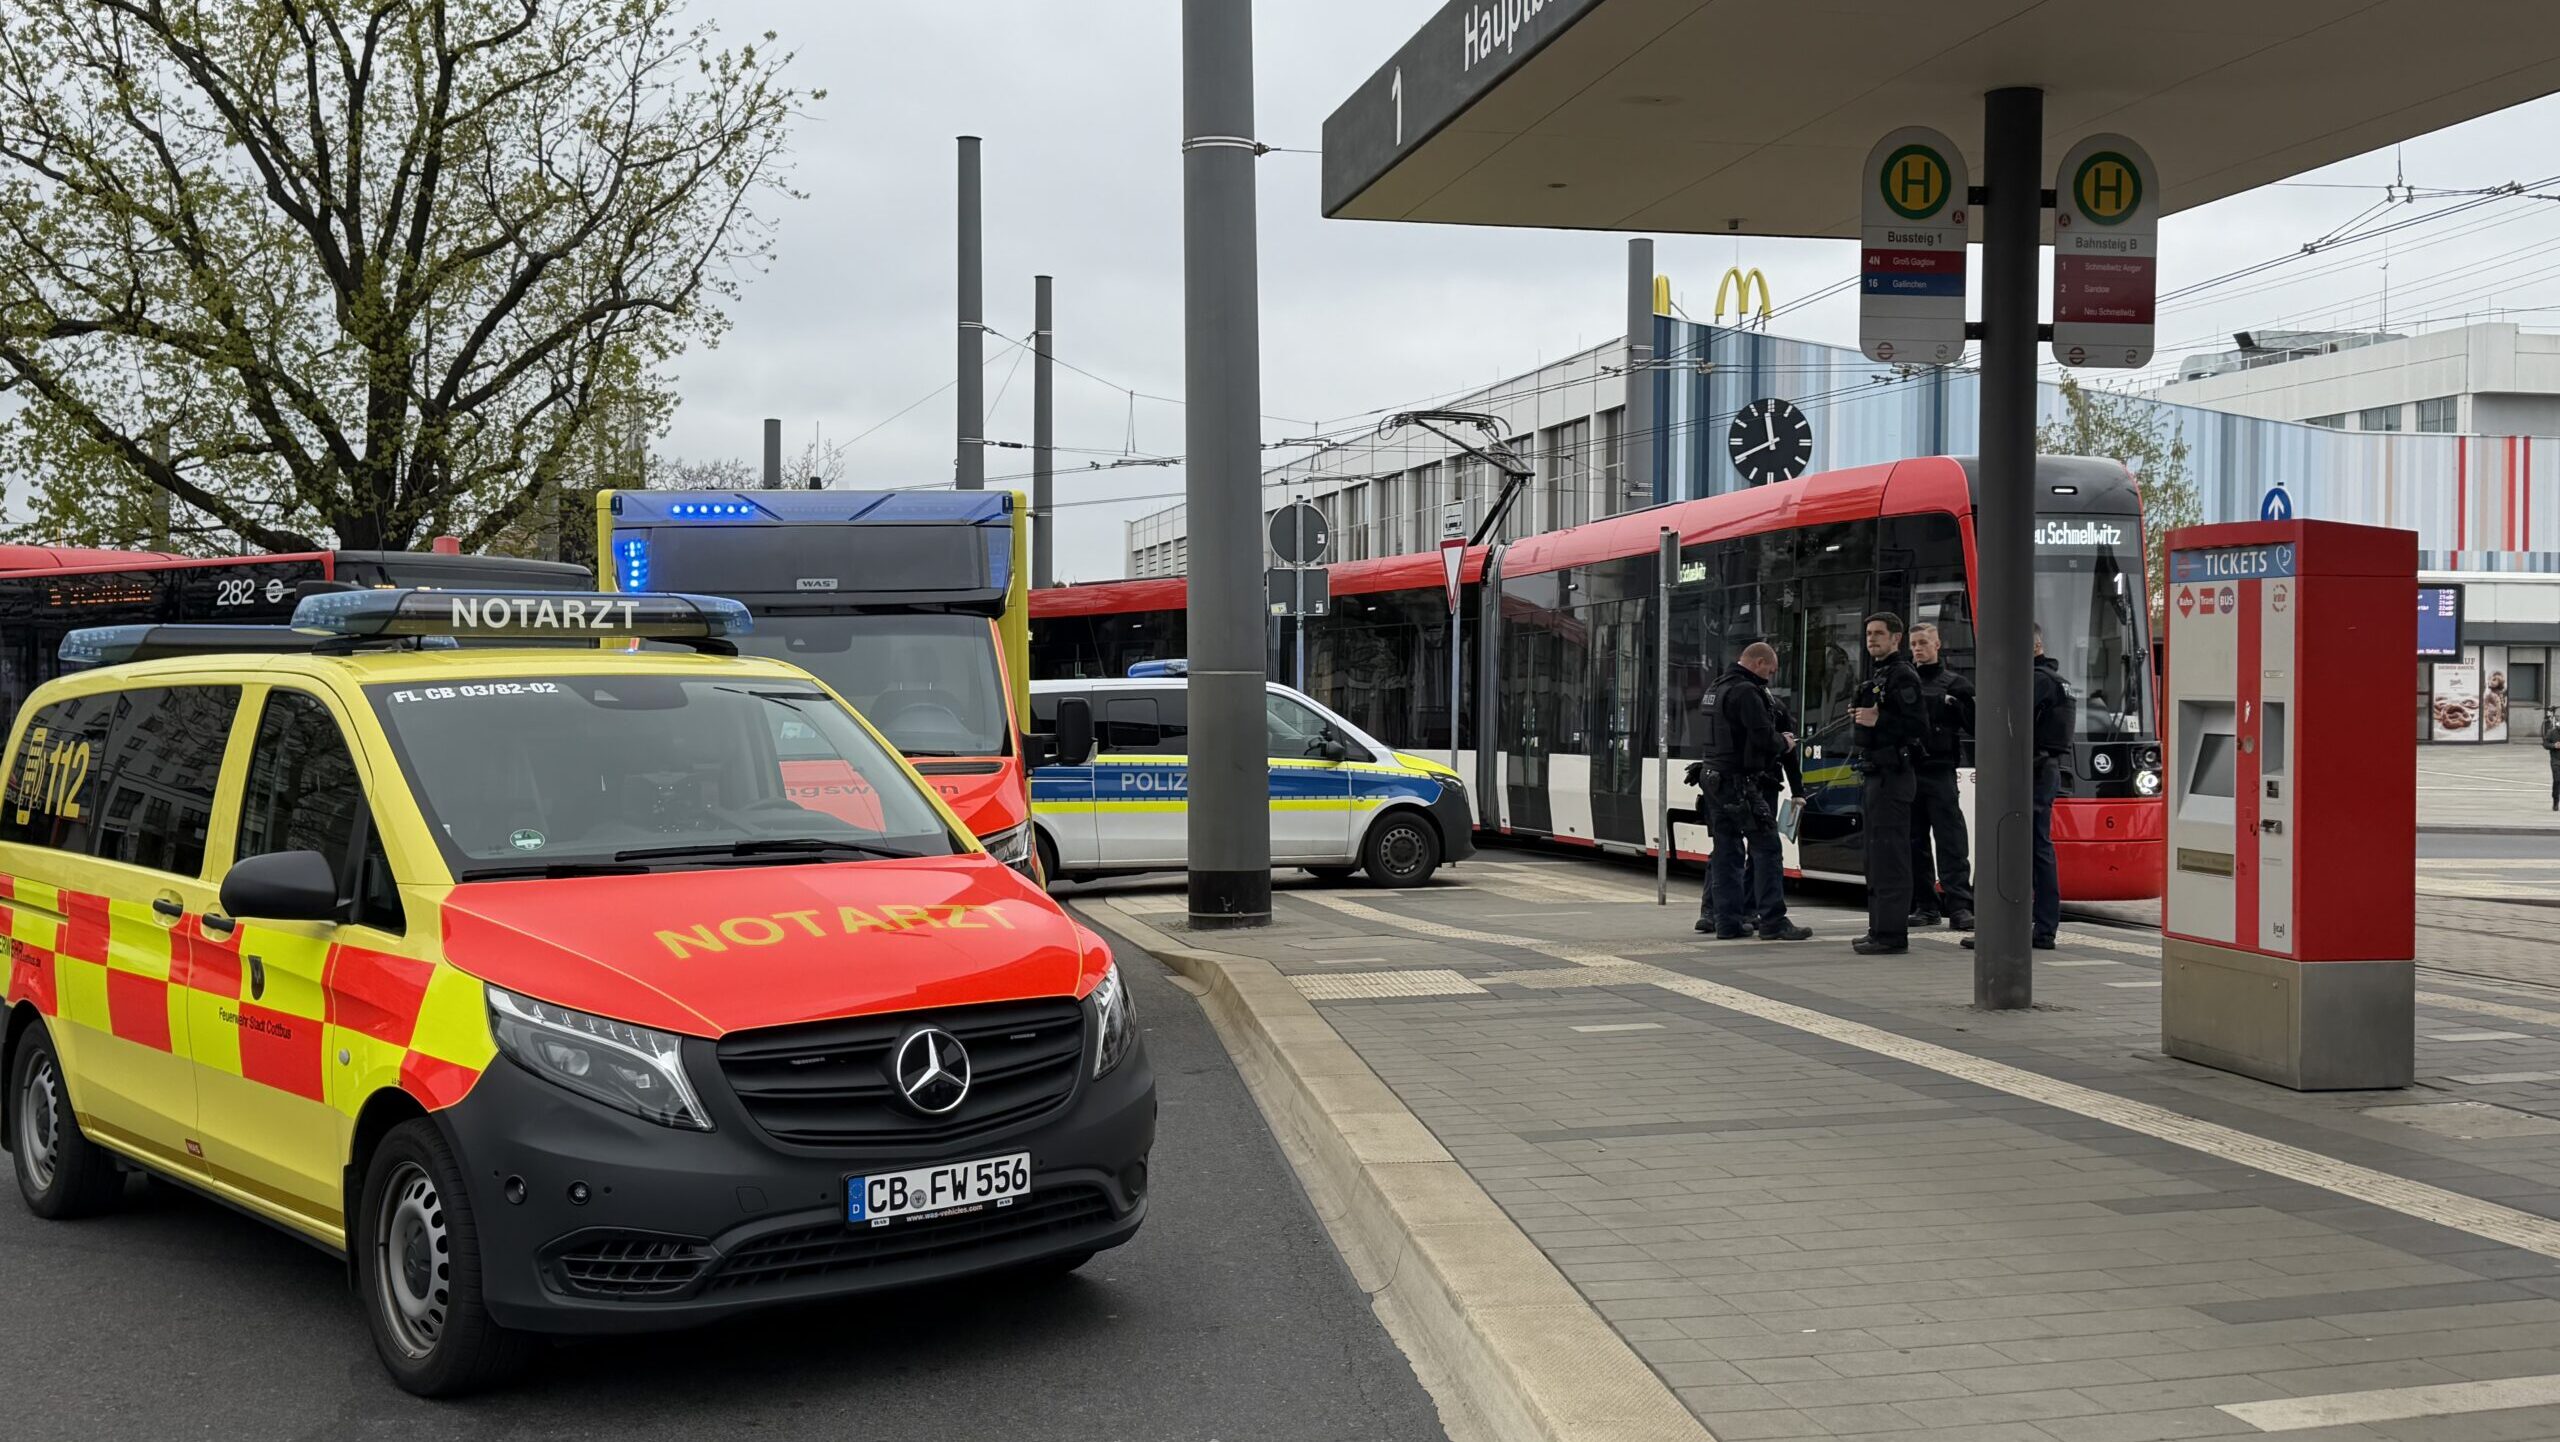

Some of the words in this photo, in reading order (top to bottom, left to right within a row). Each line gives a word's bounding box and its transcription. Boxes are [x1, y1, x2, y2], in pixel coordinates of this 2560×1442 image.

[1887, 231, 1934, 246] Bussteig
[1937, 233, 1943, 244] 1
[2075, 237, 2126, 252] Bahnsteig
[2129, 239, 2137, 250] B
[1868, 256, 1880, 265] 4N
[1868, 278, 1878, 288] 16
[2060, 284, 2066, 293] 2
[2047, 521, 2121, 545] Schmellwitz
[2205, 551, 2268, 576] TICKETS
[216, 579, 255, 606] 282
[2113, 572, 2123, 595] 1
[2219, 595, 2234, 606] BUS
[451, 597, 640, 630] NOTARZT
[393, 689, 422, 703] FL
[425, 686, 456, 699] CB
[459, 682, 559, 697] 03/82-02
[44, 740, 90, 819] 112
[1121, 772, 1188, 792] POLIZ
[653, 904, 1015, 959] NOTARZT
[218, 1006, 248, 1028] Feuerwehr
[248, 1015, 266, 1033] Stadt
[266, 1020, 292, 1040] Cottbus
[867, 1176, 909, 1213] CB
[930, 1166, 969, 1205] FW
[976, 1157, 1028, 1197] 556
[852, 1203, 860, 1214] D
[906, 1203, 983, 1222] www.was-vehicles.com
